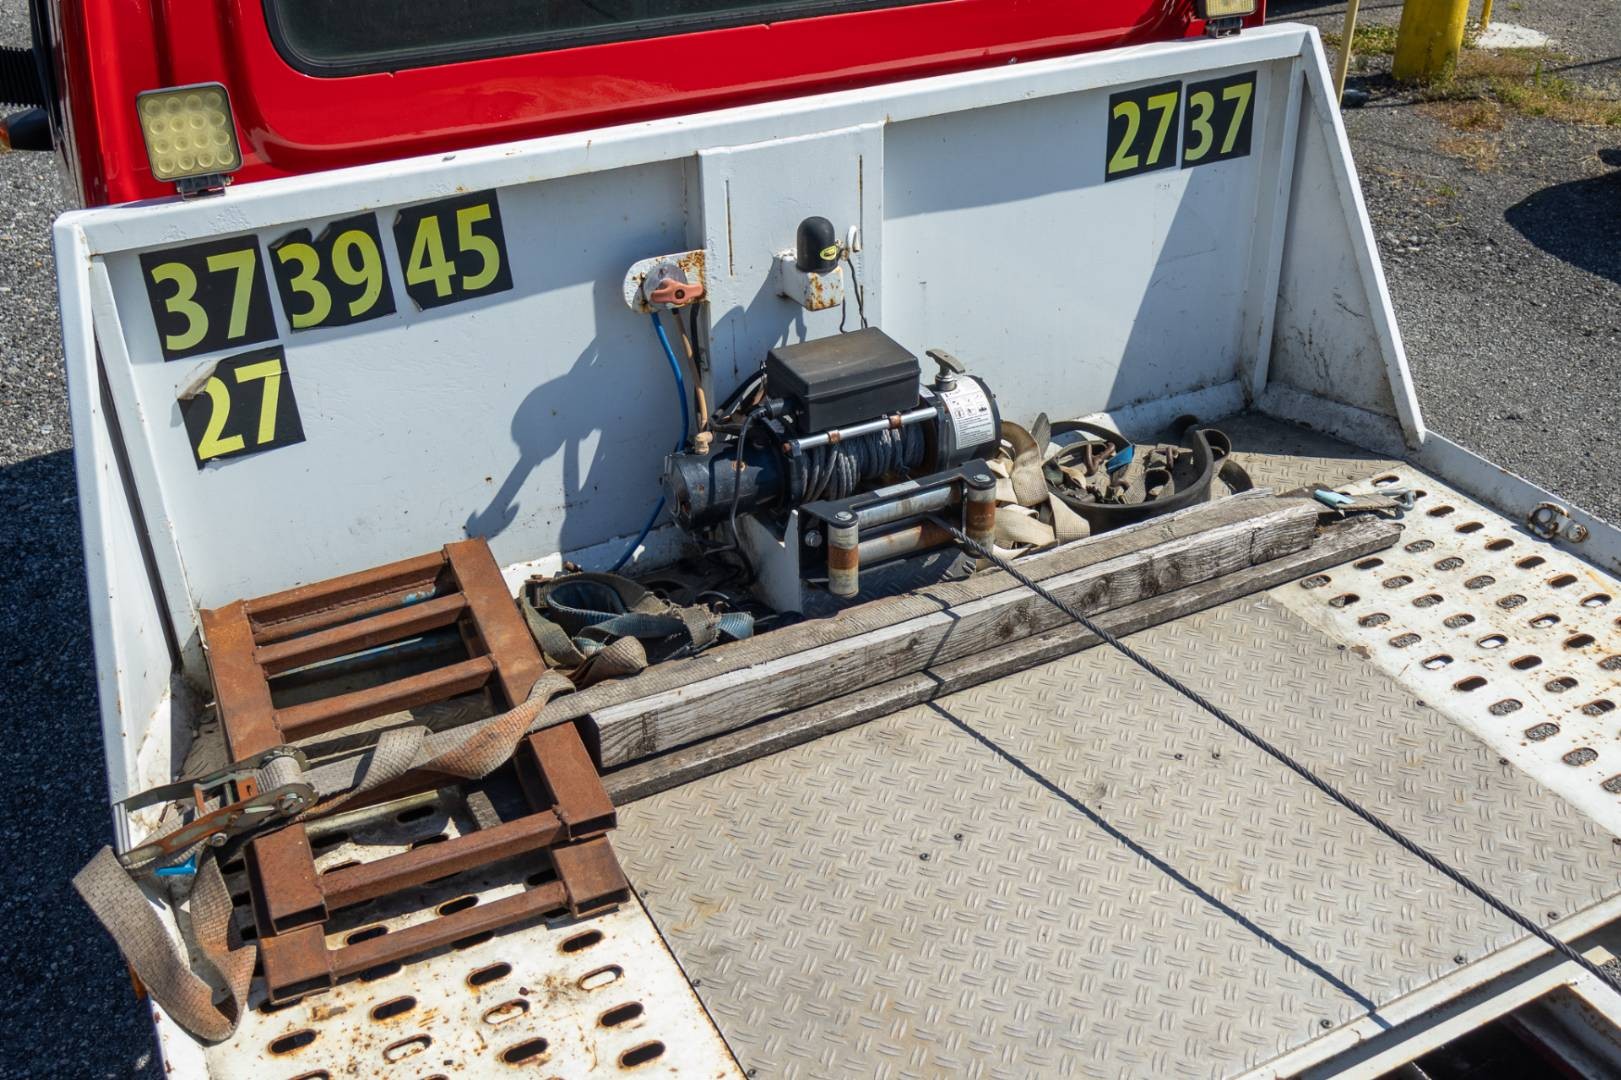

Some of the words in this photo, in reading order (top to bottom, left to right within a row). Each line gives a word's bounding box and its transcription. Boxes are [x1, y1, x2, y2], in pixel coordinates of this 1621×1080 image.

[1108, 91, 1178, 173] 27
[1184, 82, 1252, 161] 37
[151, 248, 256, 351] 37
[277, 229, 383, 329] 39
[406, 203, 499, 297] 45
[197, 359, 282, 461] 27
